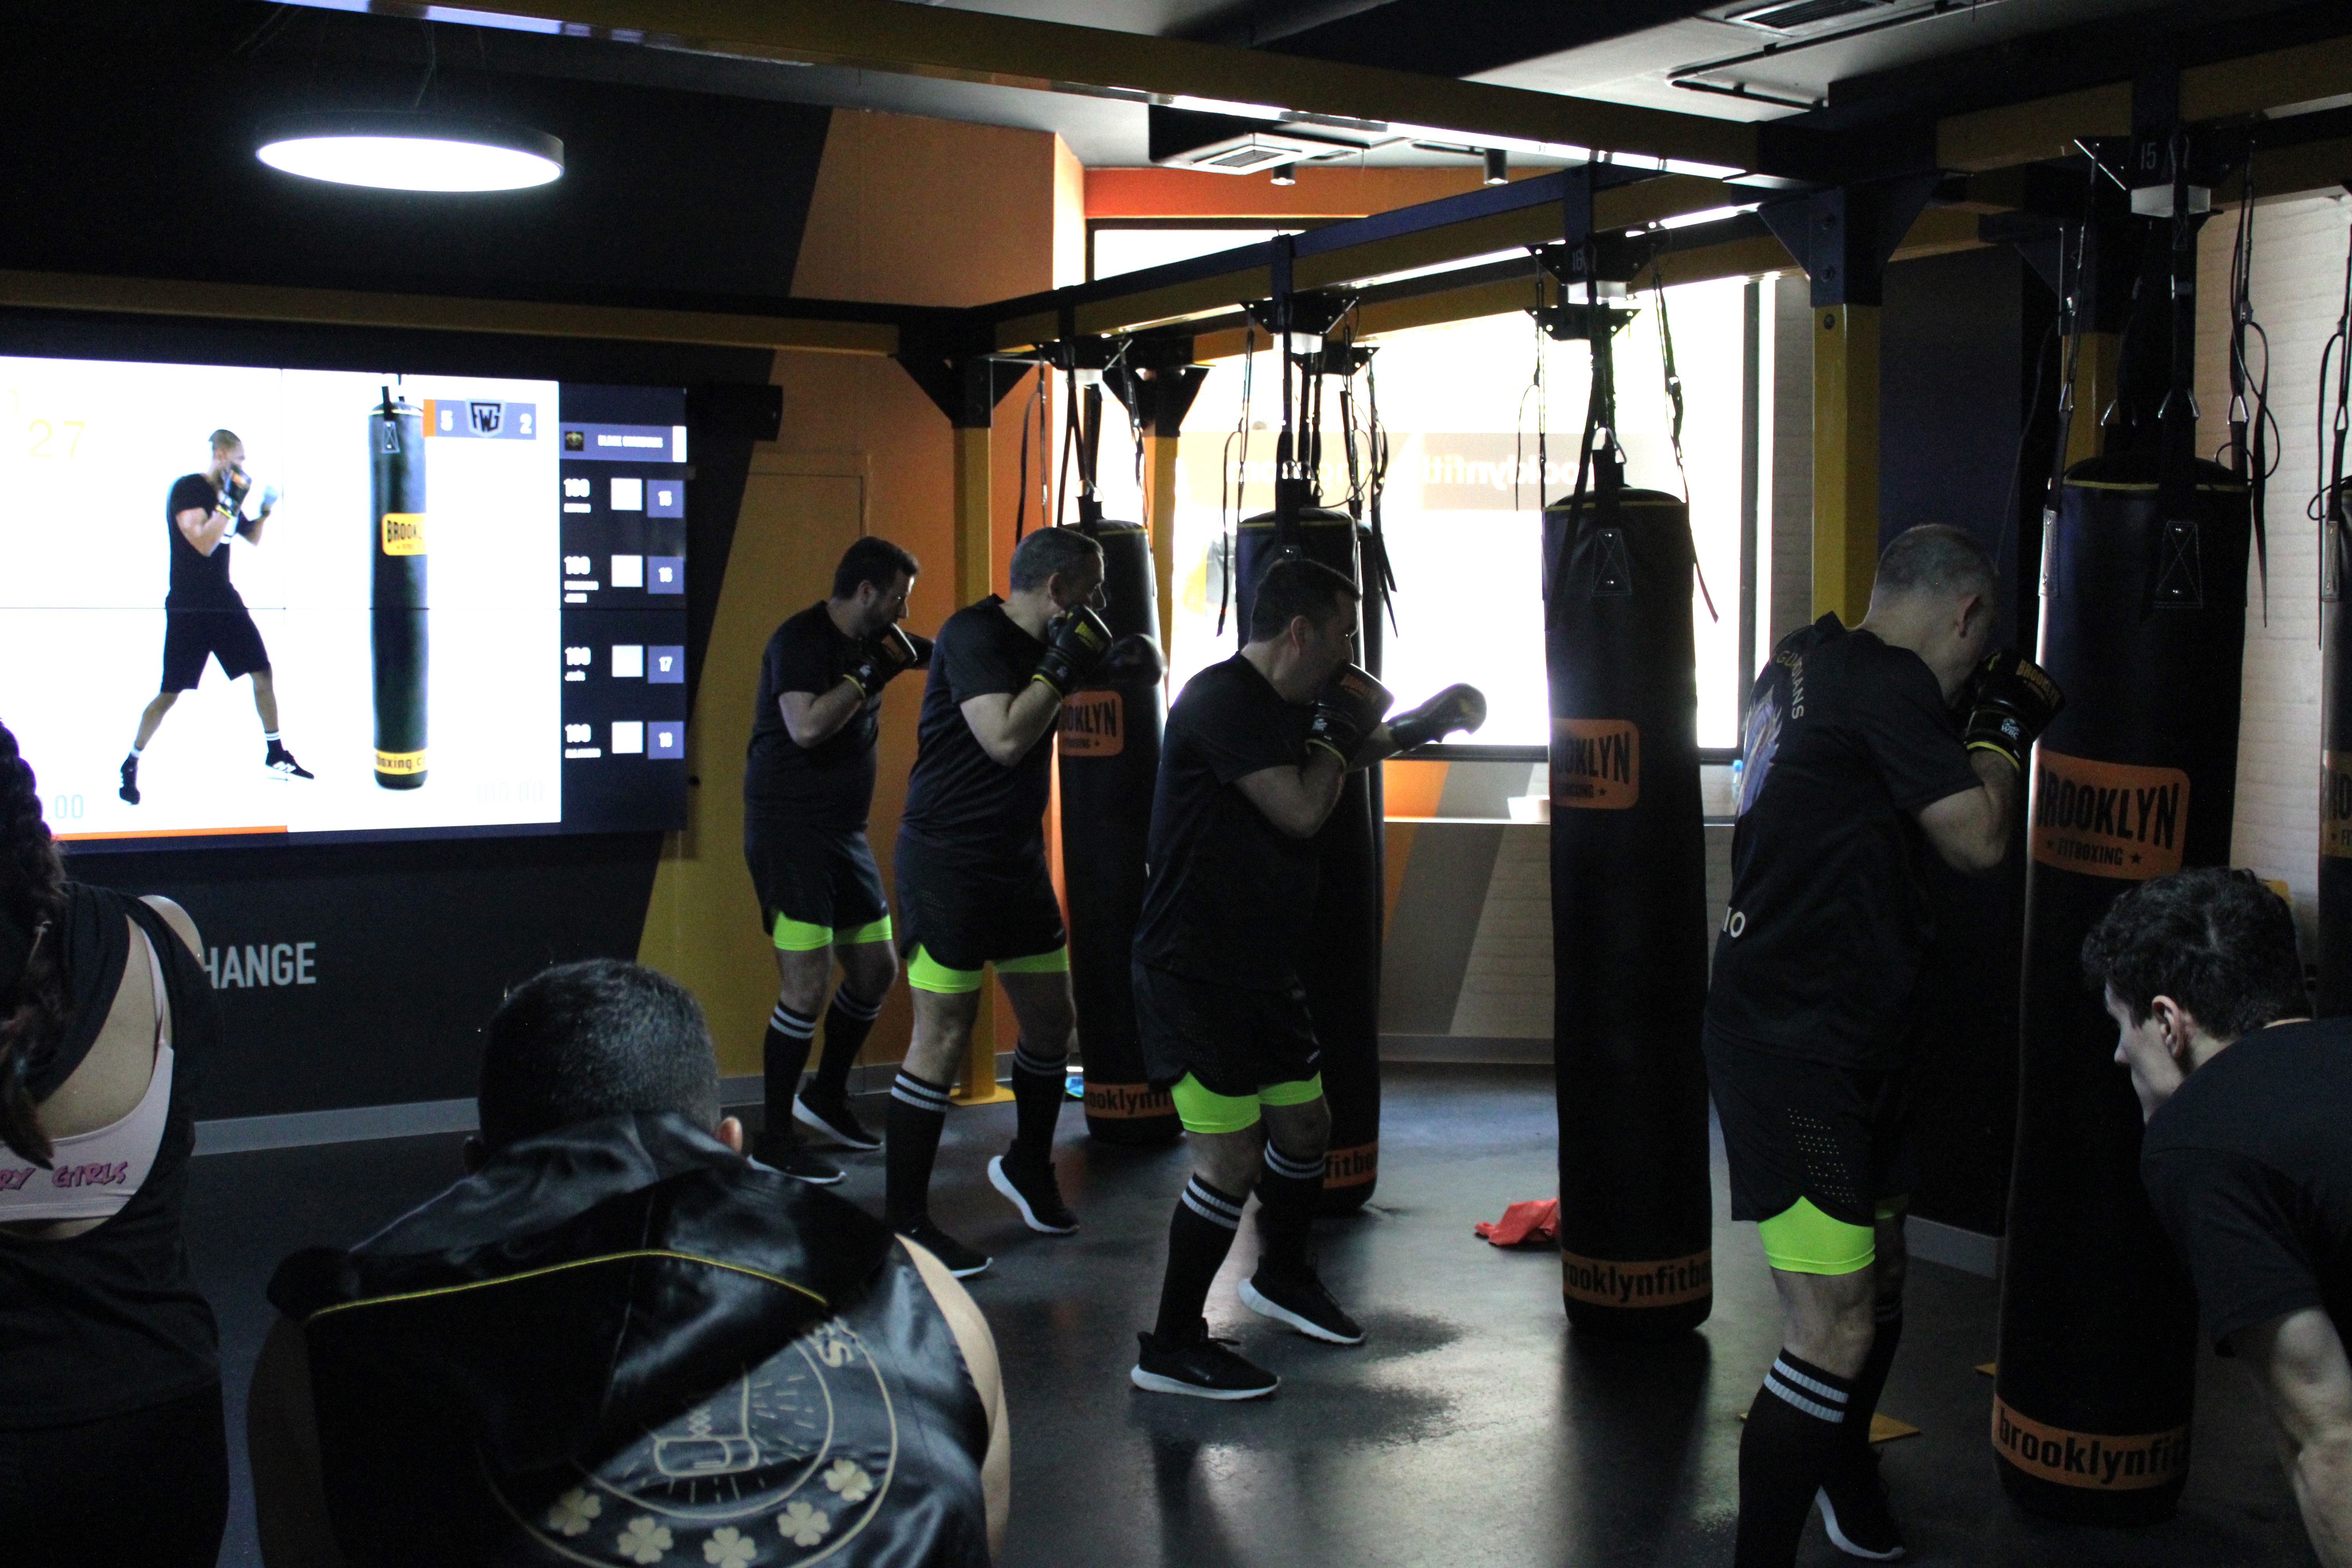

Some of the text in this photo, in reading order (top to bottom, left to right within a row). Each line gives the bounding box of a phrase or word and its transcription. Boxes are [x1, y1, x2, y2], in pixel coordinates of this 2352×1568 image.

[2141, 142, 2158, 170] 15
[440, 410, 453, 431] 5
[519, 413, 532, 434] 2
[28, 419, 86, 459] 27
[659, 656, 673, 672] 17
[2000, 724, 2019, 741] WBC
[2058, 837, 2123, 866] FITBOXING
[51, 1161, 128, 1188] GIRLS
